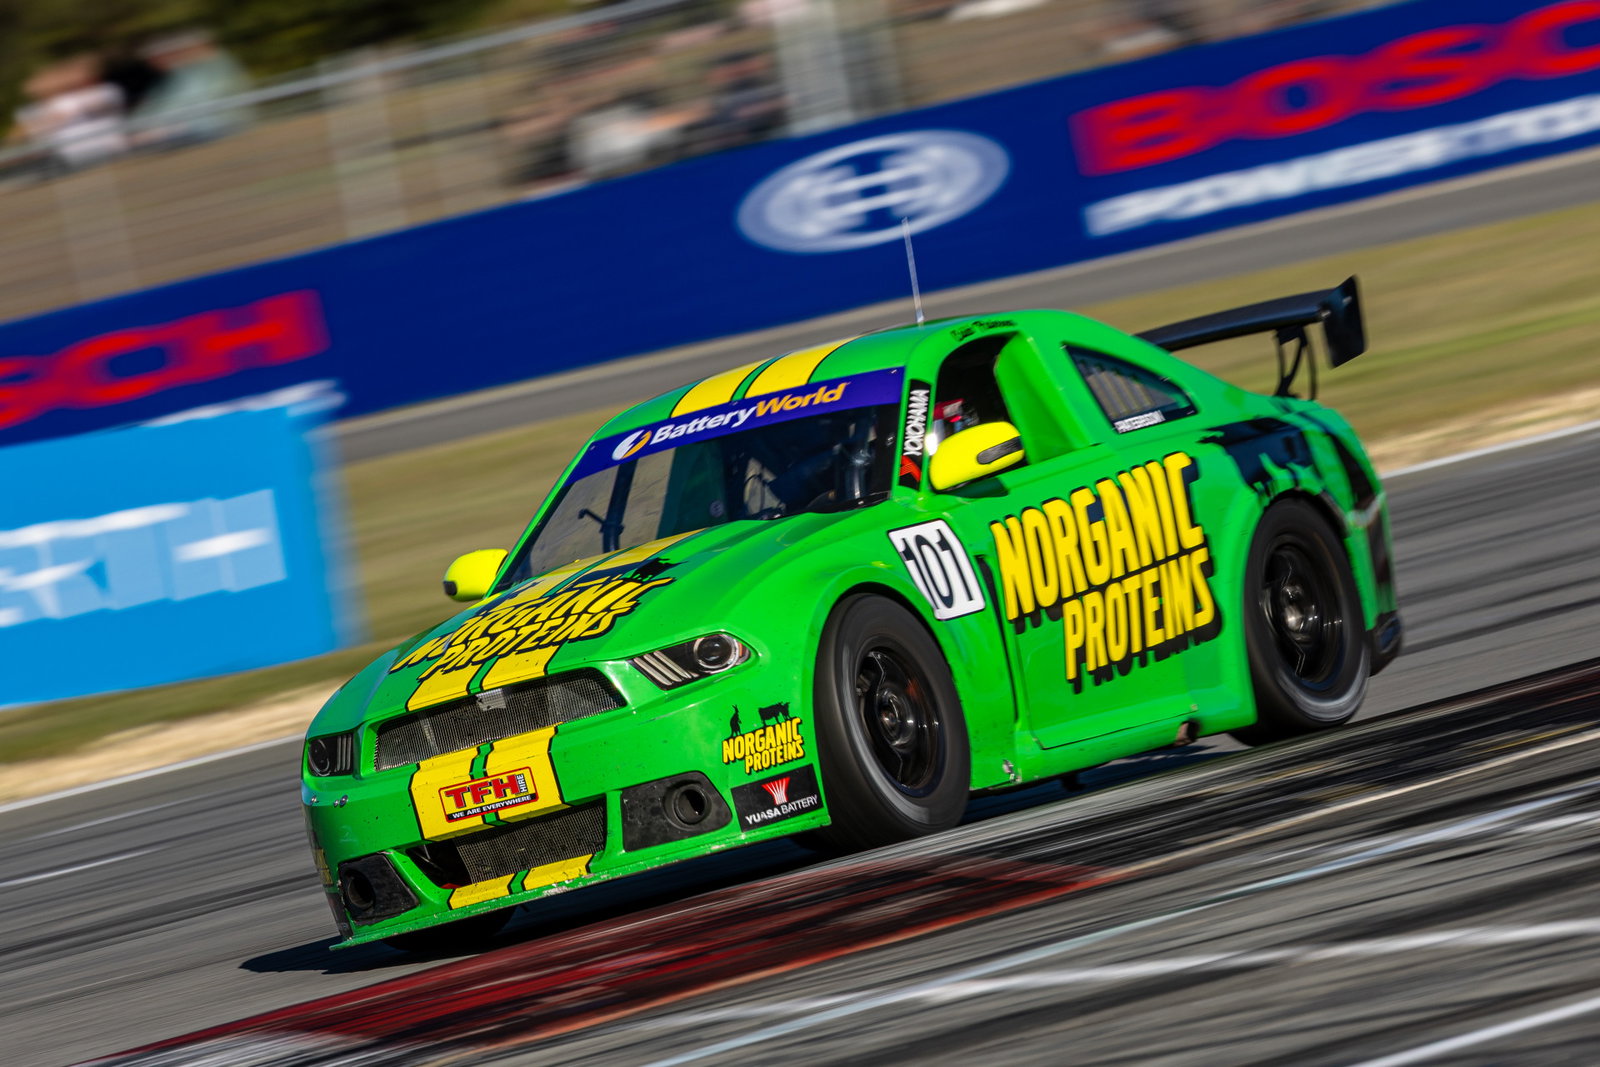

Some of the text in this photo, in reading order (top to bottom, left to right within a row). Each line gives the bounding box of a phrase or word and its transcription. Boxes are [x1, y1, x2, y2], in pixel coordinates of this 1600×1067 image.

[903, 389, 930, 456] YOKOHAMA
[990, 452, 1206, 621] NORGANIC
[900, 528, 974, 609] 101
[389, 574, 675, 673] NORGANIC
[1062, 547, 1216, 681] PROTEINS
[417, 607, 638, 682] PROTEINS
[722, 717, 802, 763] NORGANIC
[745, 739, 804, 774] PROTEINS
[444, 774, 521, 809] TFH
[452, 795, 531, 819] WE ARE EVERYWHERE
[516, 774, 528, 793] HIRE
[745, 795, 818, 825] YUASA BATTERY
